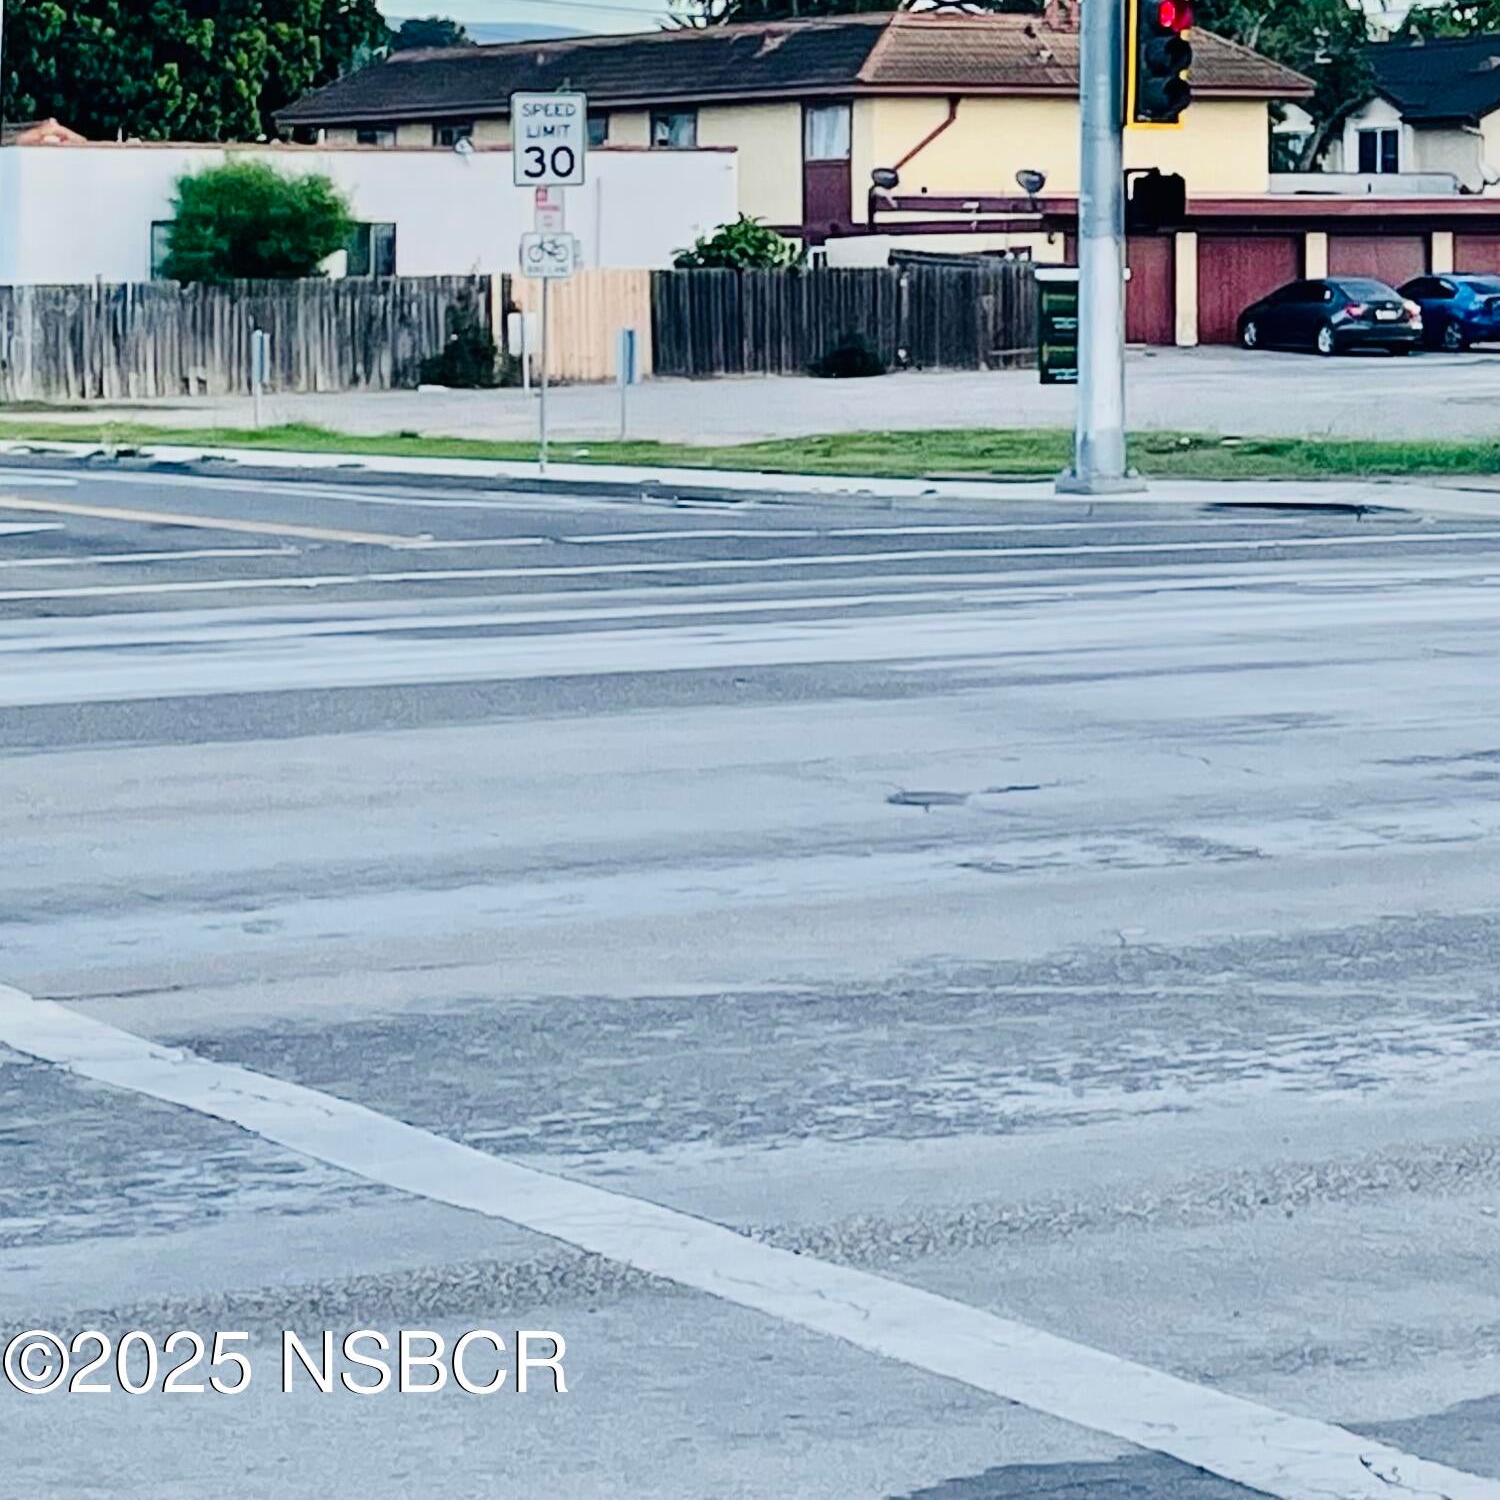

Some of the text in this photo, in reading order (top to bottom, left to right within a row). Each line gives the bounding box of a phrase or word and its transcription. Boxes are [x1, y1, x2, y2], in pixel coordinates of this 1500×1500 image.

[521, 103, 577, 118] SPEED
[526, 124, 571, 139] LIMIT
[523, 146, 575, 178] 30
